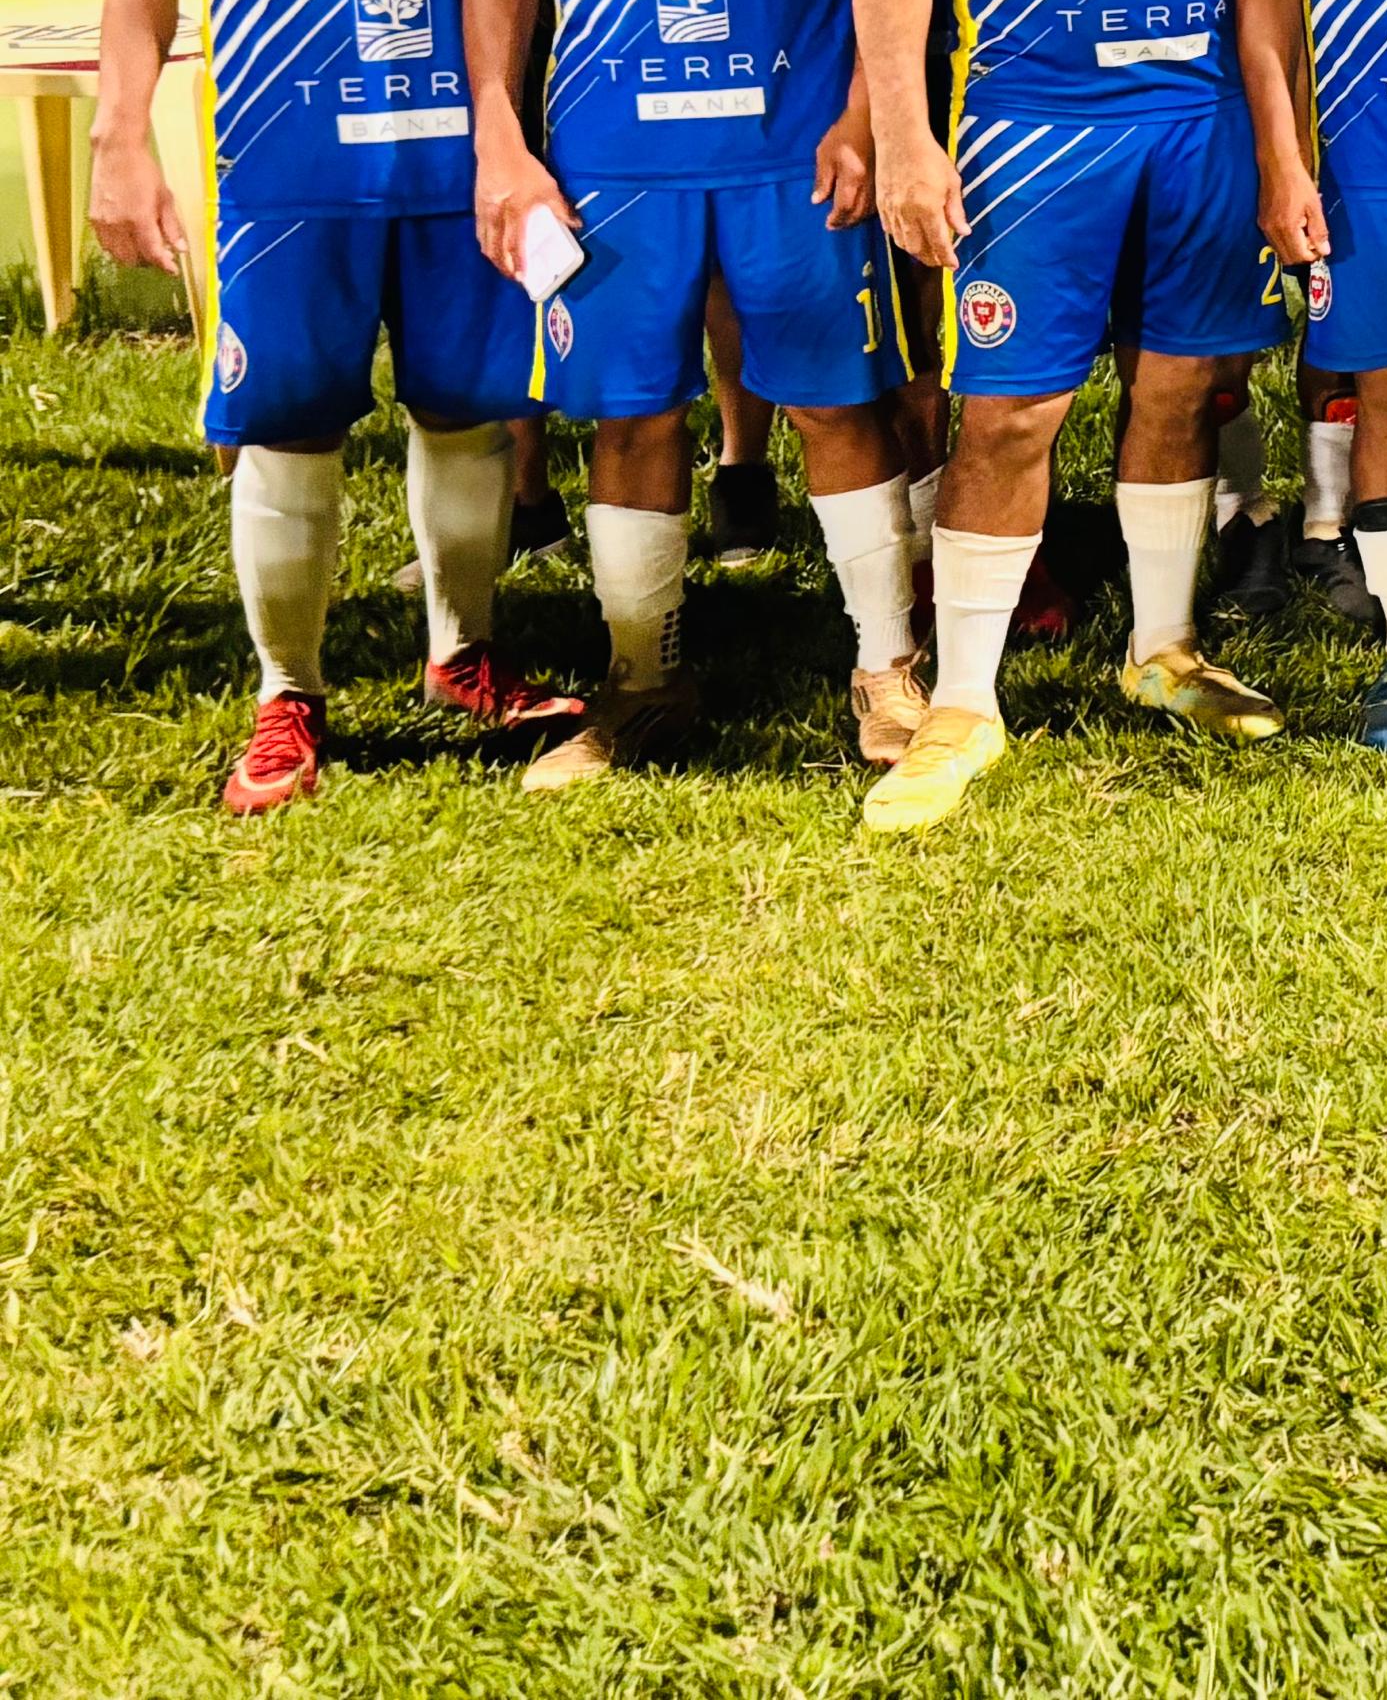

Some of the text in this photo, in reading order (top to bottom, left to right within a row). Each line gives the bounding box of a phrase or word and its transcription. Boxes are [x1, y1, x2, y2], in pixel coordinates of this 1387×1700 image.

[1056, 1, 1227, 32] TERRA
[602, 49, 791, 83] TERRA
[296, 71, 461, 105] TERR
[652, 93, 751, 116] BANK
[352, 115, 455, 138] BANK
